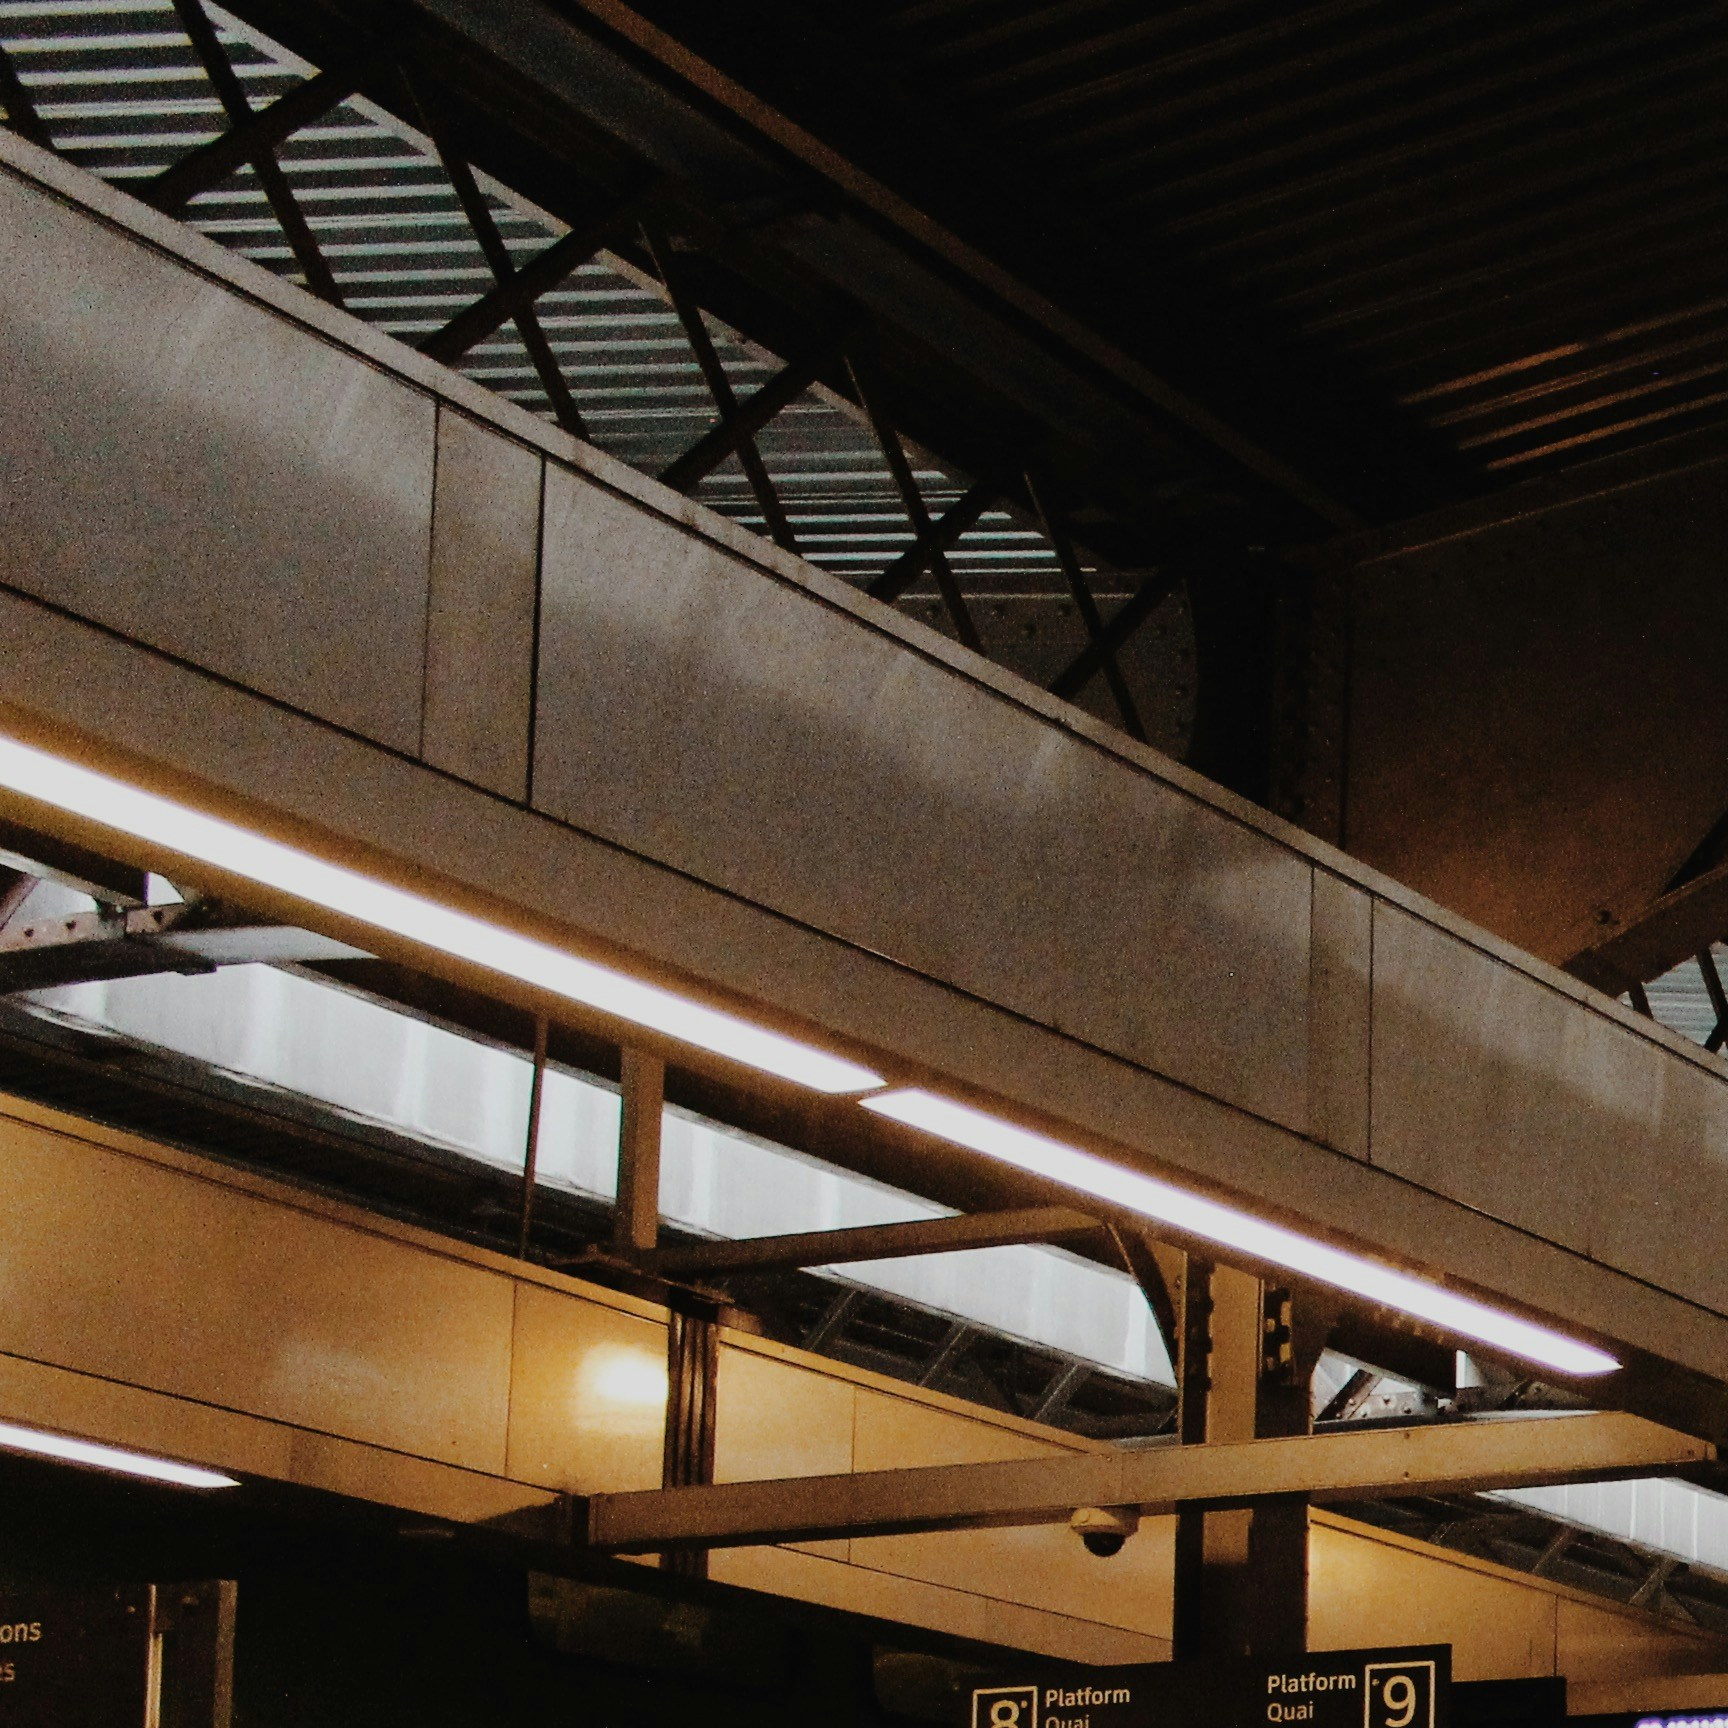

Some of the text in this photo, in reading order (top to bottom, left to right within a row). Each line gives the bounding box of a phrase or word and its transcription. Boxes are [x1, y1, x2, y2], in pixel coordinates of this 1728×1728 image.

[1266, 1671, 1357, 1694] Platform
[1045, 1686, 1131, 1708] Platform
[1382, 1674, 1417, 1728] 9
[1266, 1700, 1314, 1723] Quai
